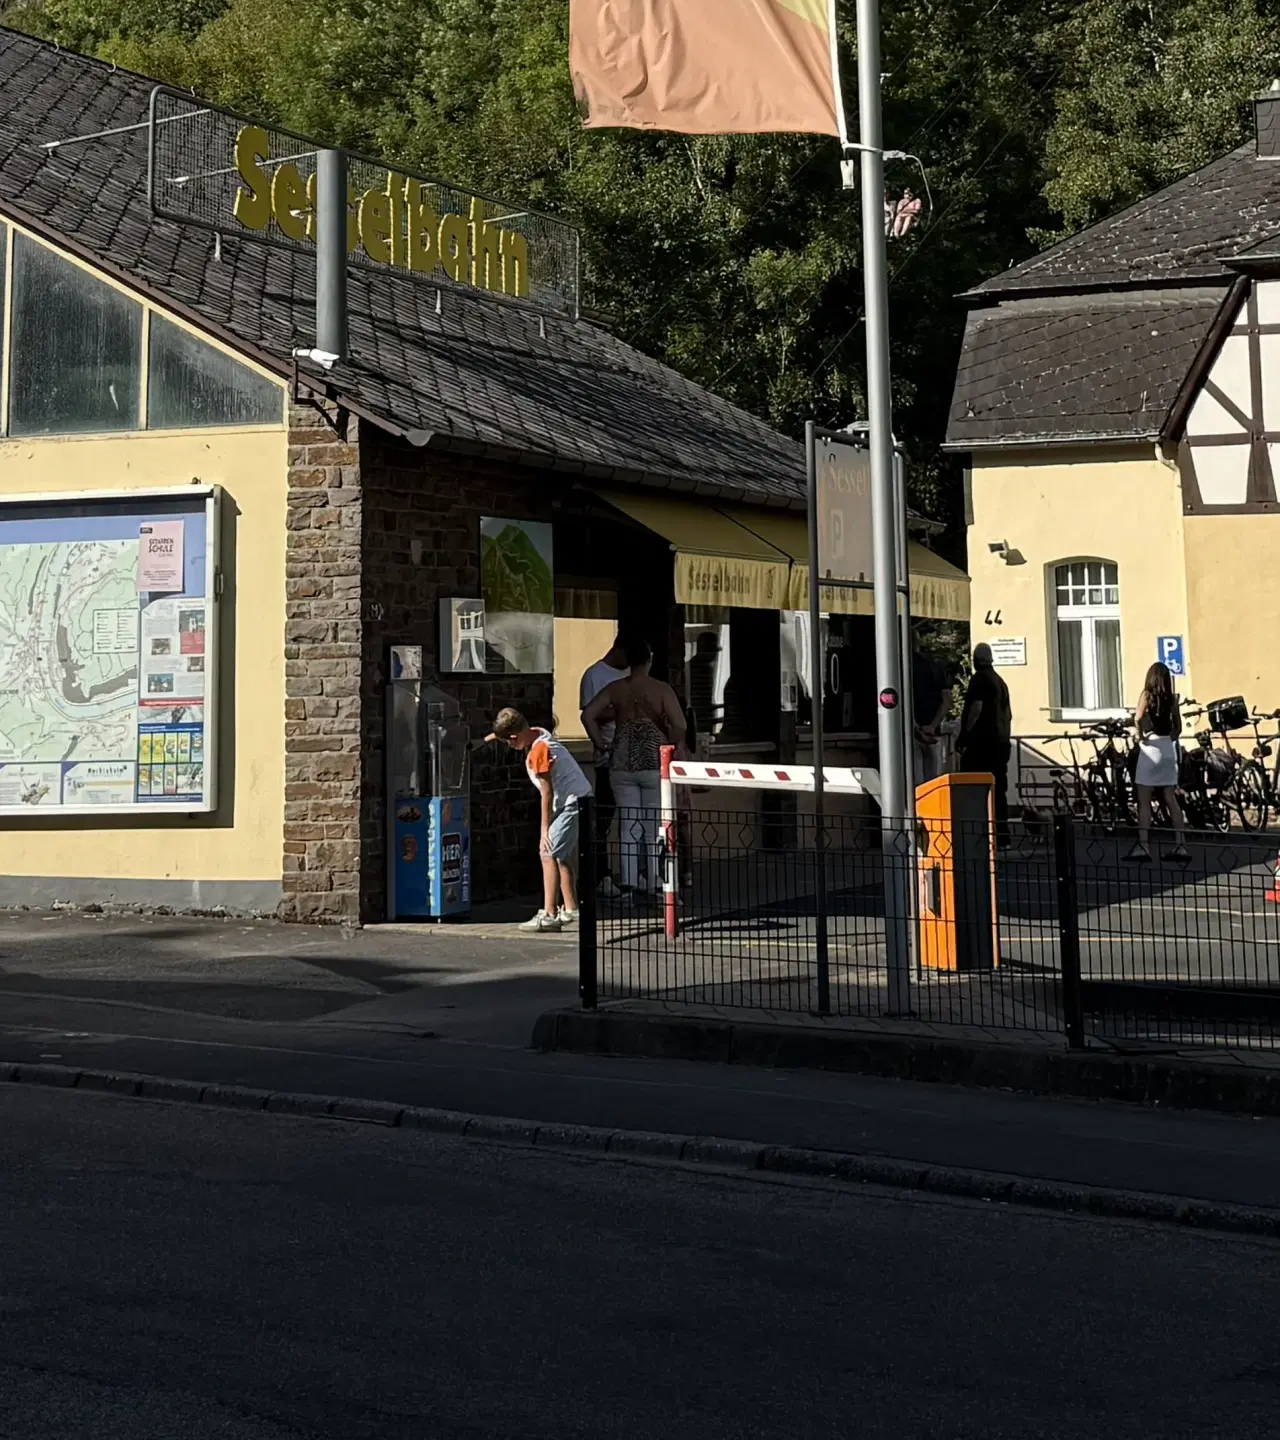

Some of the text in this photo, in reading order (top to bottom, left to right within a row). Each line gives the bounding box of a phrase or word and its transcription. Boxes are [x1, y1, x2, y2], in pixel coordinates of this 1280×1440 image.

[687, 563, 751, 595] Sesselbahn
[984, 609, 1003, 626] 44
[1163, 638, 1178, 660] P
